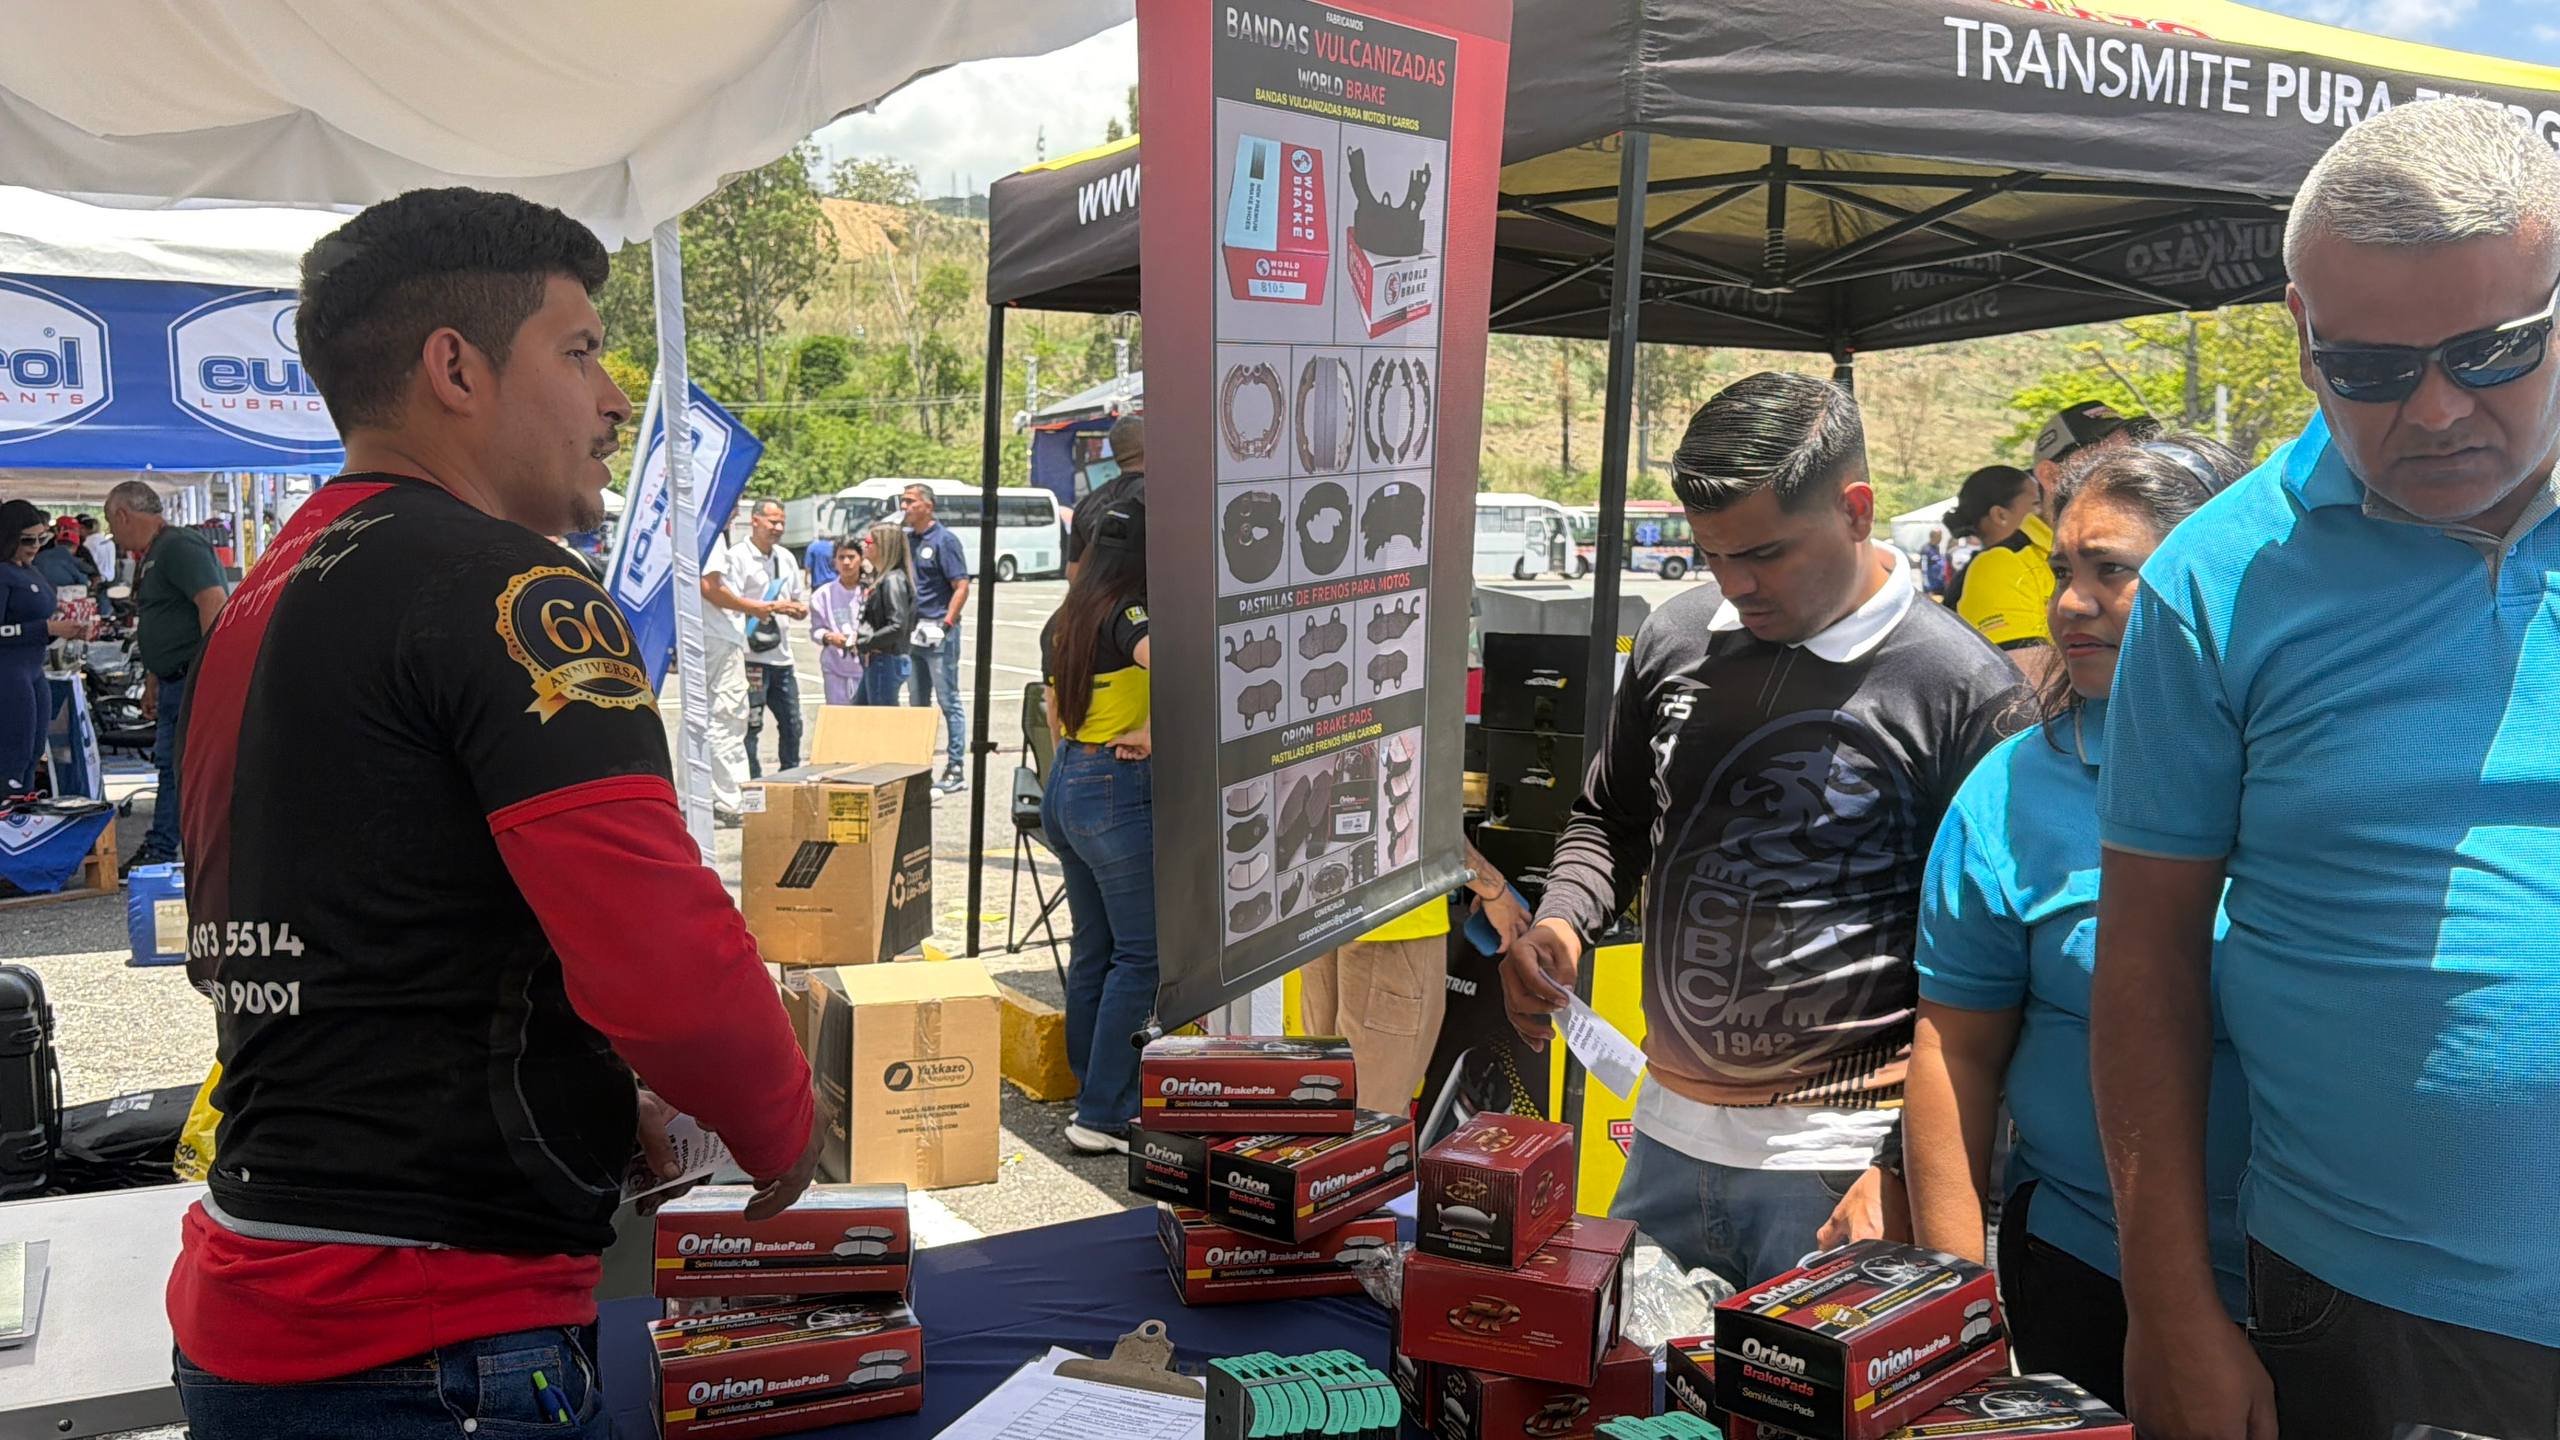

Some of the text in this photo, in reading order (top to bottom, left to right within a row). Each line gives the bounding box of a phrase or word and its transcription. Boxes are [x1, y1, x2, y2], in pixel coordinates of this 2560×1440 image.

[1326, 12, 1364, 31] FABRICAMOS
[1226, 7, 1446, 87] BANDAS VULCANIZADAS
[1298, 68, 1386, 106] WORLD BRAKE
[1944, 16, 2253, 115] TRANSMITE
[2266, 62, 2391, 127] PURA
[1255, 87, 1288, 106] BANDAS
[1288, 95, 1342, 117] VULCANIZADAS
[1343, 108, 1361, 120] PARA
[1363, 111, 1386, 124] MOTOS
[1292, 176, 1302, 238] BRAKE
[1303, 176, 1314, 240] WORLD
[1271, 259, 1300, 269] WORLD
[1271, 269, 1299, 278] BRAKE
[1401, 269, 1428, 283] WORLD
[1239, 573, 1410, 616] PASTILLAS DE FRENOS PARA MOTOS
[541, 599, 630, 657] 60
[1281, 707, 1373, 747] ORION BRAKE PADS
[1271, 723, 1383, 766] PASTILLAS DE FRENOS PARA CARROS
[225, 921, 305, 957] 5514
[231, 980, 300, 1015] 9001
[1712, 1029, 1796, 1057] 1942
[1160, 1077, 1275, 1096] Orion BrakePads
[1145, 1142, 1184, 1165] Orion
[1228, 1171, 1270, 1195] Orion
[1310, 1174, 1346, 1200] Orion
[1229, 1190, 1275, 1209] BrakePads
[678, 1233, 815, 1256] Orion BrakePads
[1205, 1246, 1320, 1266] Orion BrakePads
[1750, 1277, 1808, 1305] Orion
[674, 1311, 756, 1328] Orion
[1742, 1337, 1806, 1375] Orion
[1868, 1346, 1913, 1387] Orion
[1914, 1334, 1951, 1361] BrakePads
[688, 1374, 830, 1404] Orion BrakePads
[1676, 1375, 1707, 1416] Orion
[1743, 1364, 1814, 1397] BrakePads
[1793, 1402, 1816, 1418] Pads
